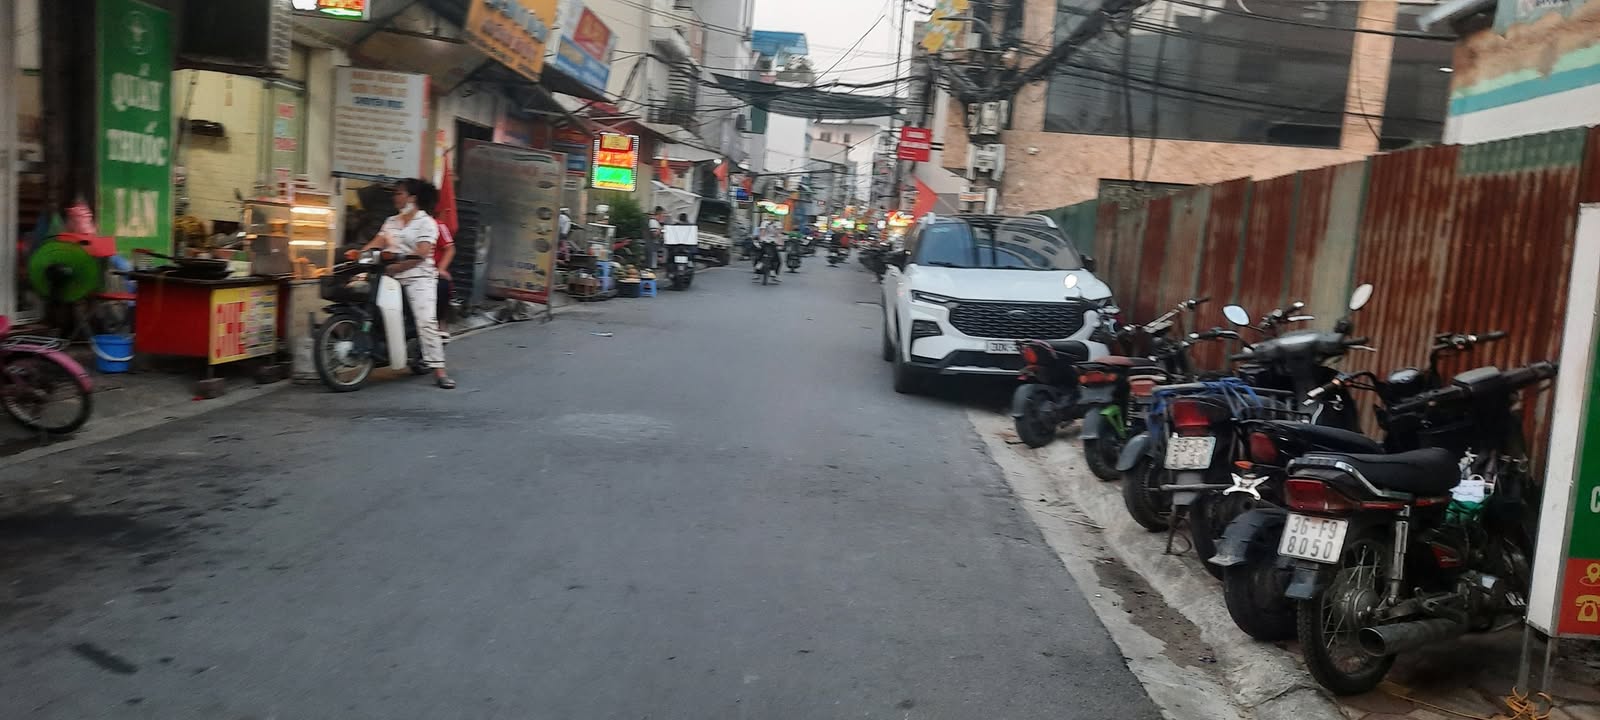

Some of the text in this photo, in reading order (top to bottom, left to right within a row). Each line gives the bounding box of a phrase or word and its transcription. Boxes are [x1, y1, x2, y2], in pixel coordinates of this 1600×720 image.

[106, 121, 167, 166] THUỐC
[114, 187, 159, 237] LAN
[1290, 516, 1339, 541] 36-F9
[1286, 535, 1334, 559] 8050
